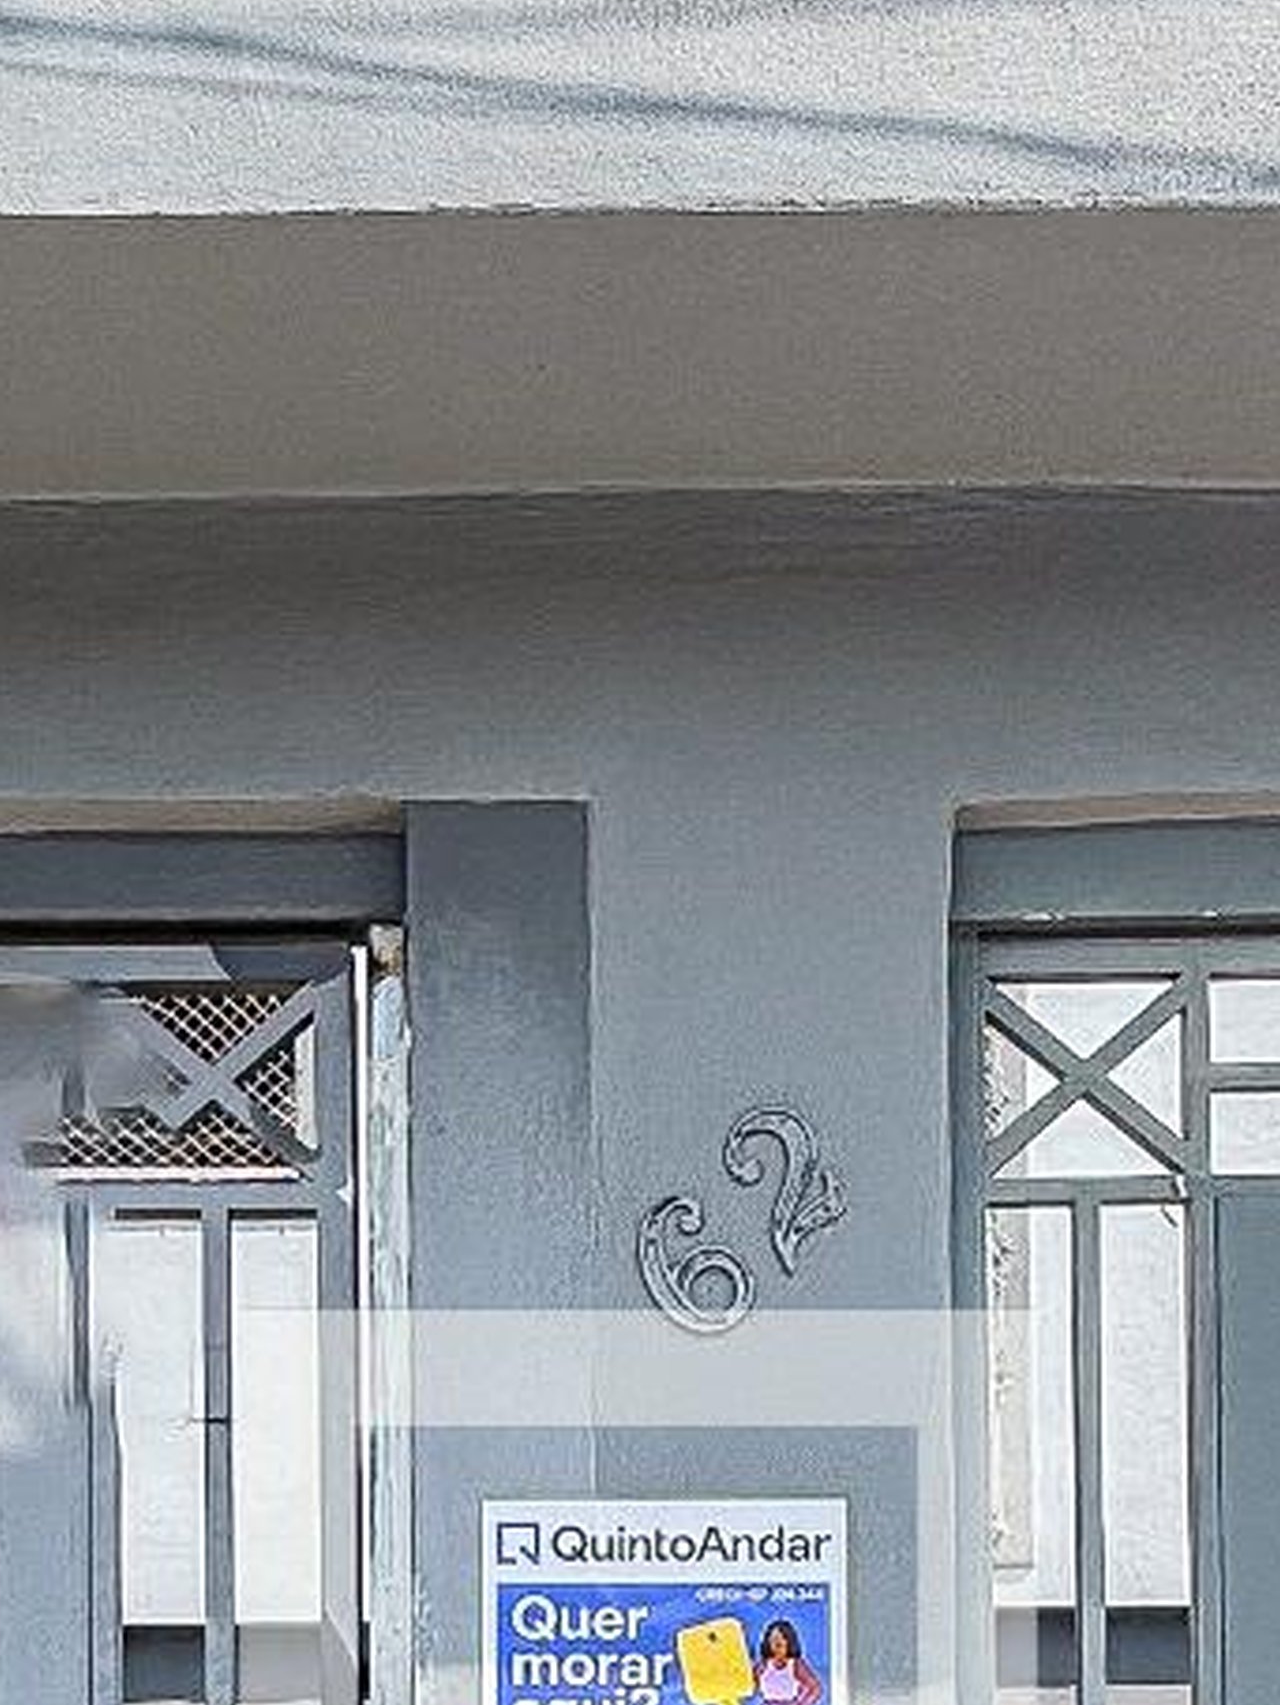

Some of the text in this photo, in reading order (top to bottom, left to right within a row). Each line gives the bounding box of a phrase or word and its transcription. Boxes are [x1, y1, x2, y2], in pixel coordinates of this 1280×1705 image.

[550, 1523, 833, 1563] QuintoAndar
[510, 1595, 649, 1642] Quer
[511, 1649, 673, 1687] morar
